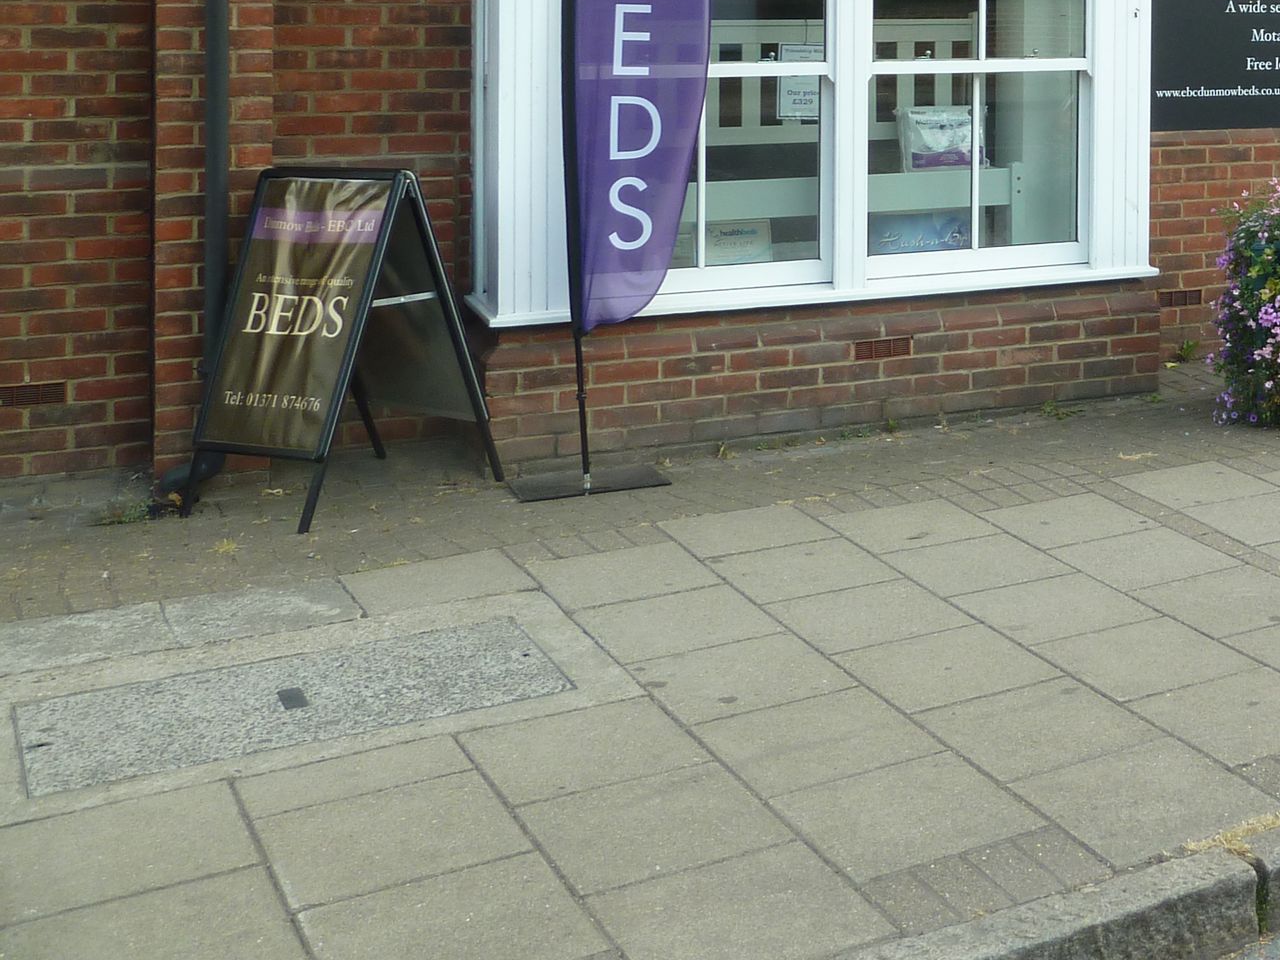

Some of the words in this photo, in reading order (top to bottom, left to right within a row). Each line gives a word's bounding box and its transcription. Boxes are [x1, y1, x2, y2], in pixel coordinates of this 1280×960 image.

[1224, 0, 1236, 13] A
[1238, 0, 1267, 14] wide
[1246, 57, 1272, 71] Free
[357, 219, 376, 232] Ltd
[242, 292, 351, 339] BEDS
[224, 390, 244, 406] Tel:
[245, 392, 279, 409] 01371
[281, 394, 322, 412] 874676
